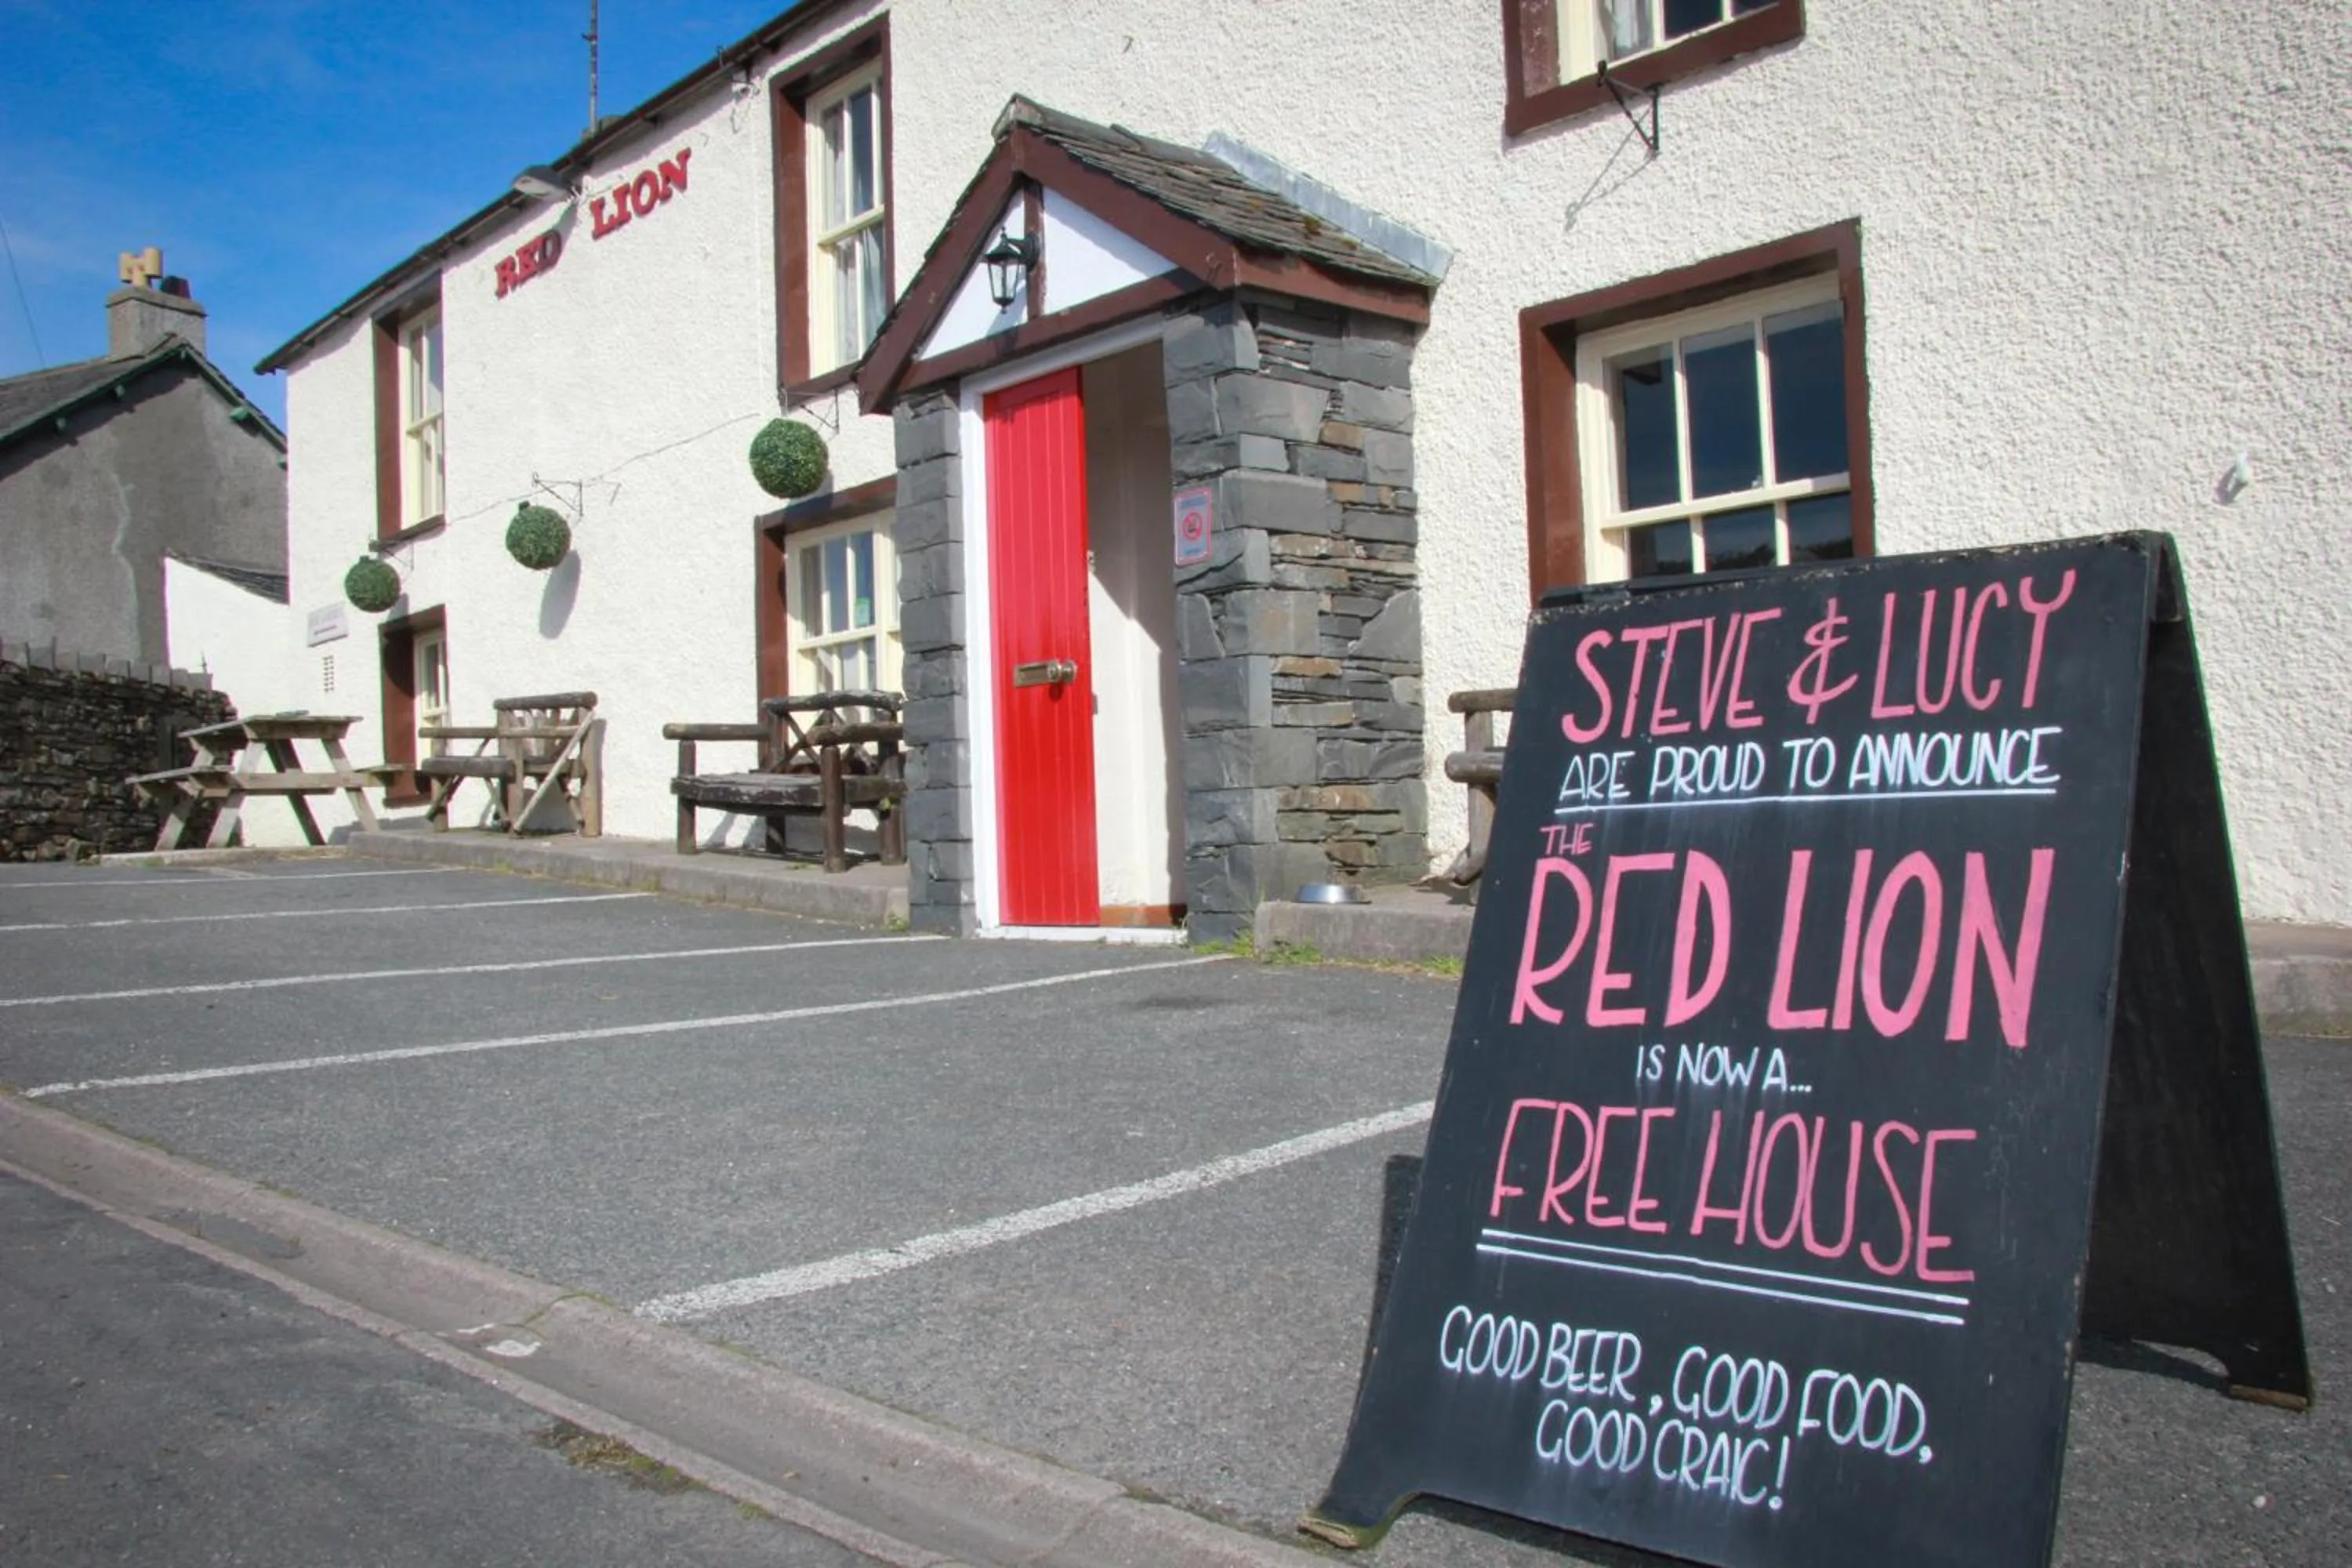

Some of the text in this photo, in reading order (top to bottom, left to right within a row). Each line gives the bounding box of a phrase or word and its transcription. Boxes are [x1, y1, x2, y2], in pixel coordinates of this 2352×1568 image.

[495, 147, 691, 300] RED LION
[1561, 569, 2076, 744] STEVE & LUCY
[1540, 822, 1594, 856] THE
[1559, 725, 2063, 803] ARE PROUD TO ANNOUNCE
[1509, 848, 2056, 1049] RED LION
[1635, 1044, 1664, 1082] IS
[1675, 1044, 1756, 1088] NOW
[1490, 1098, 1977, 1283] FREE HOUSE
[1439, 1305, 1540, 1382] GOOD
[1672, 1345, 1789, 1431] GOOD
[1798, 1370, 1933, 1464] FOOD,
[1535, 1399, 1791, 1511] GOOD CRAIC!
